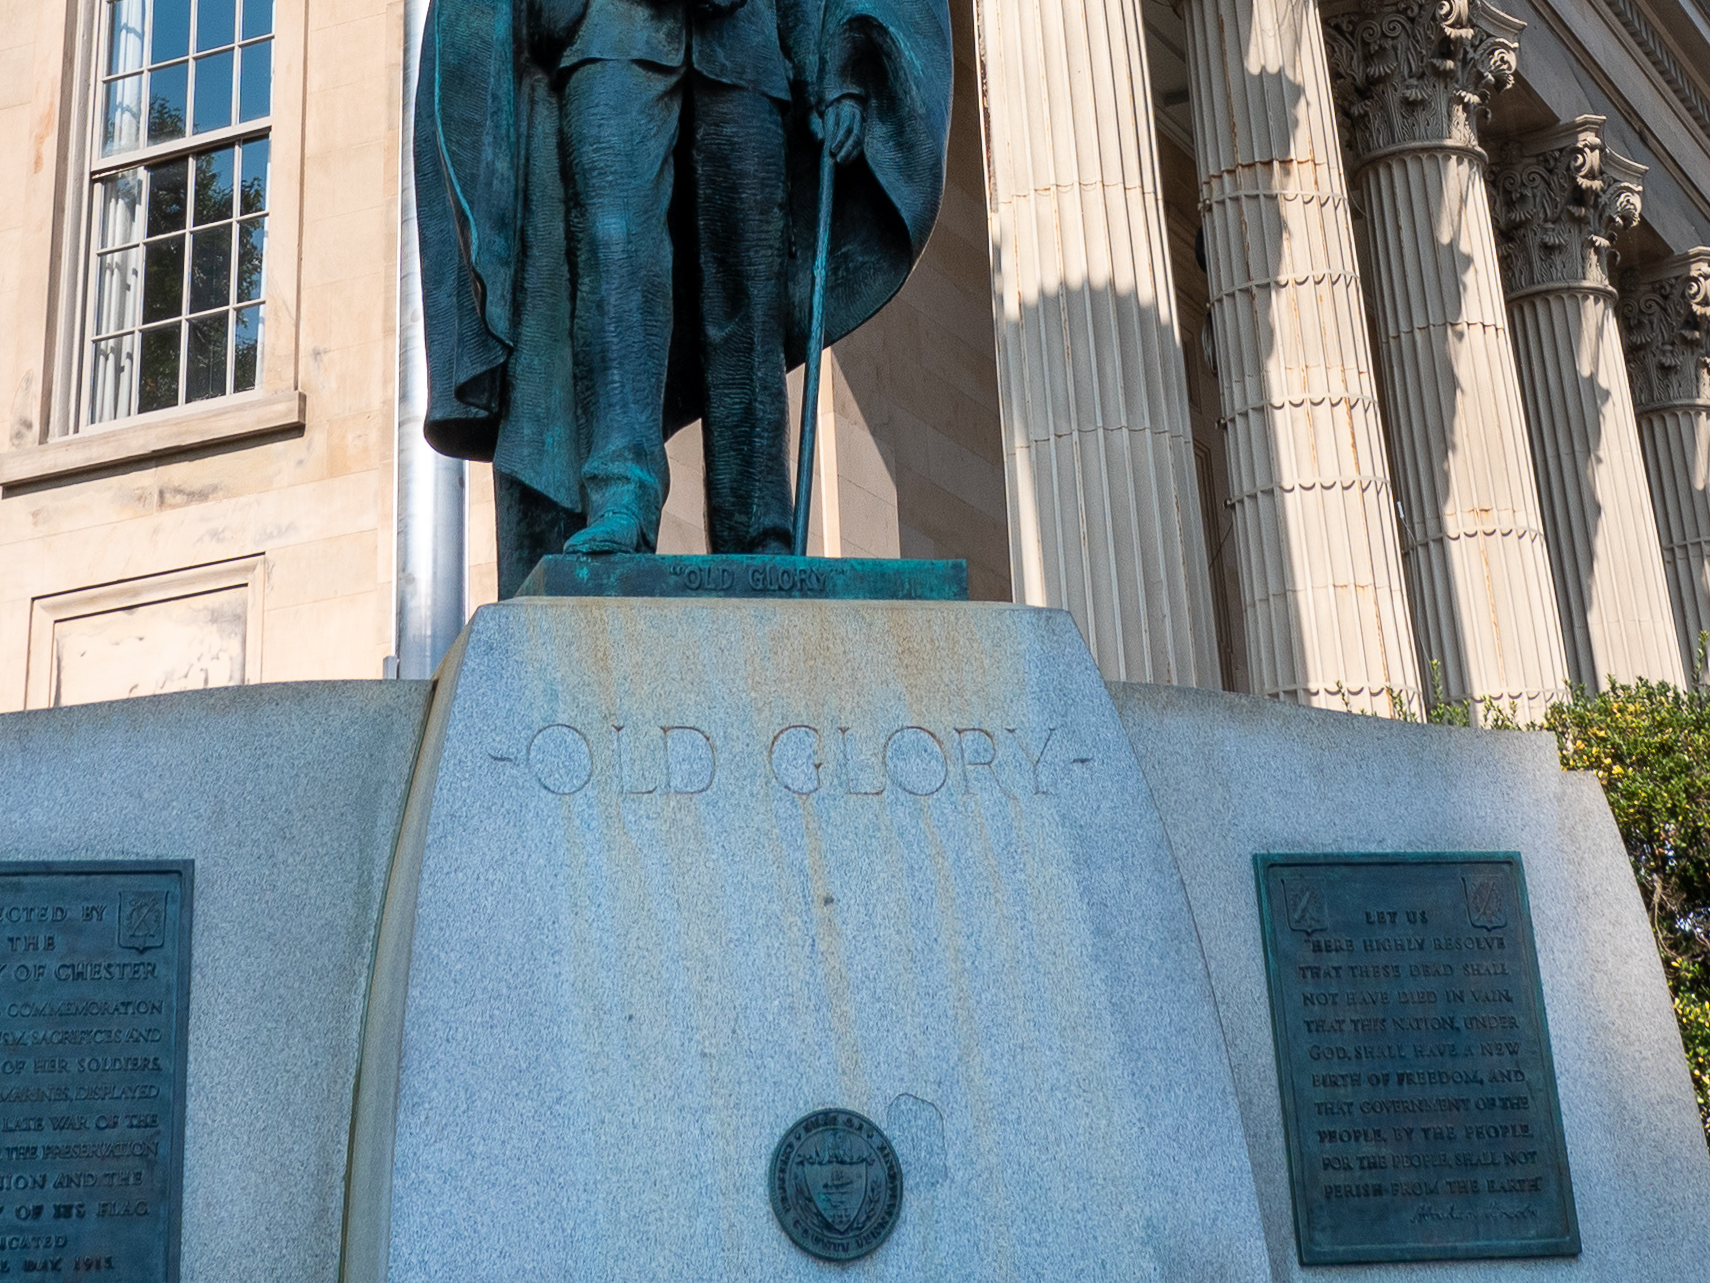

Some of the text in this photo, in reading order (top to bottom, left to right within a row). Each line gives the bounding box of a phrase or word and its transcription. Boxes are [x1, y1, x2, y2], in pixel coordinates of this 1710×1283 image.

[81, 905, 107, 922] BY
[1365, 910, 1428, 924] LET US
[7, 935, 56, 951] THE
[1362, 937, 1425, 952] HIGHLY
[1433, 936, 1506, 951] RESOLVE
[14, 964, 47, 982] OF
[54, 962, 157, 982] CHESTER
[1298, 963, 1509, 980] THAT THESE DEAD SHALL
[1302, 992, 1338, 1007] NOT
[1346, 991, 1390, 1004] HAVE
[1398, 991, 1437, 1004] DIED
[1445, 990, 1465, 1003] IN
[7, 1000, 163, 1017] COMMEMORATION
[1303, 1019, 1344, 1034] THAT
[1351, 1018, 1386, 1032] THIS
[1464, 1015, 1520, 1030] UNDER
[124, 1028, 162, 1044] AND
[1354, 1044, 1405, 1060] SHALL
[1413, 1043, 1458, 1056] HAVE
[1464, 1043, 1474, 1056] A
[1480, 1041, 1523, 1056] NEW
[1, 1060, 26, 1075] OF
[33, 1059, 69, 1073] HER
[1312, 1073, 1362, 1088] BIRTH
[1368, 1073, 1390, 1086] OF
[1488, 1069, 1525, 1082] AND
[75, 1084, 160, 1100] DISPLAYED
[1315, 1096, 1530, 1116] THAT GOVERNMENT OF THE
[1, 1117, 44, 1132] LATE
[50, 1116, 87, 1131] WAR
[94, 1115, 119, 1130] OF
[125, 1114, 158, 1128] THE
[1392, 1127, 1415, 1142] BY
[1421, 1126, 1457, 1141] THE
[6, 1145, 39, 1160] THE
[1322, 1156, 1354, 1171] FOR
[1356, 1155, 1388, 1169] THE
[1455, 1152, 1499, 1167] SHALL
[1503, 1150, 1538, 1165] NOT
[53, 1173, 97, 1188] AND
[100, 1171, 143, 1186] THE
[1323, 1183, 1384, 1199] PERISH
[1390, 1181, 1439, 1196] FROM
[1446, 1179, 1480, 1194] THE
[15, 1204, 44, 1220] OF
[96, 1201, 150, 1217] FLAG
